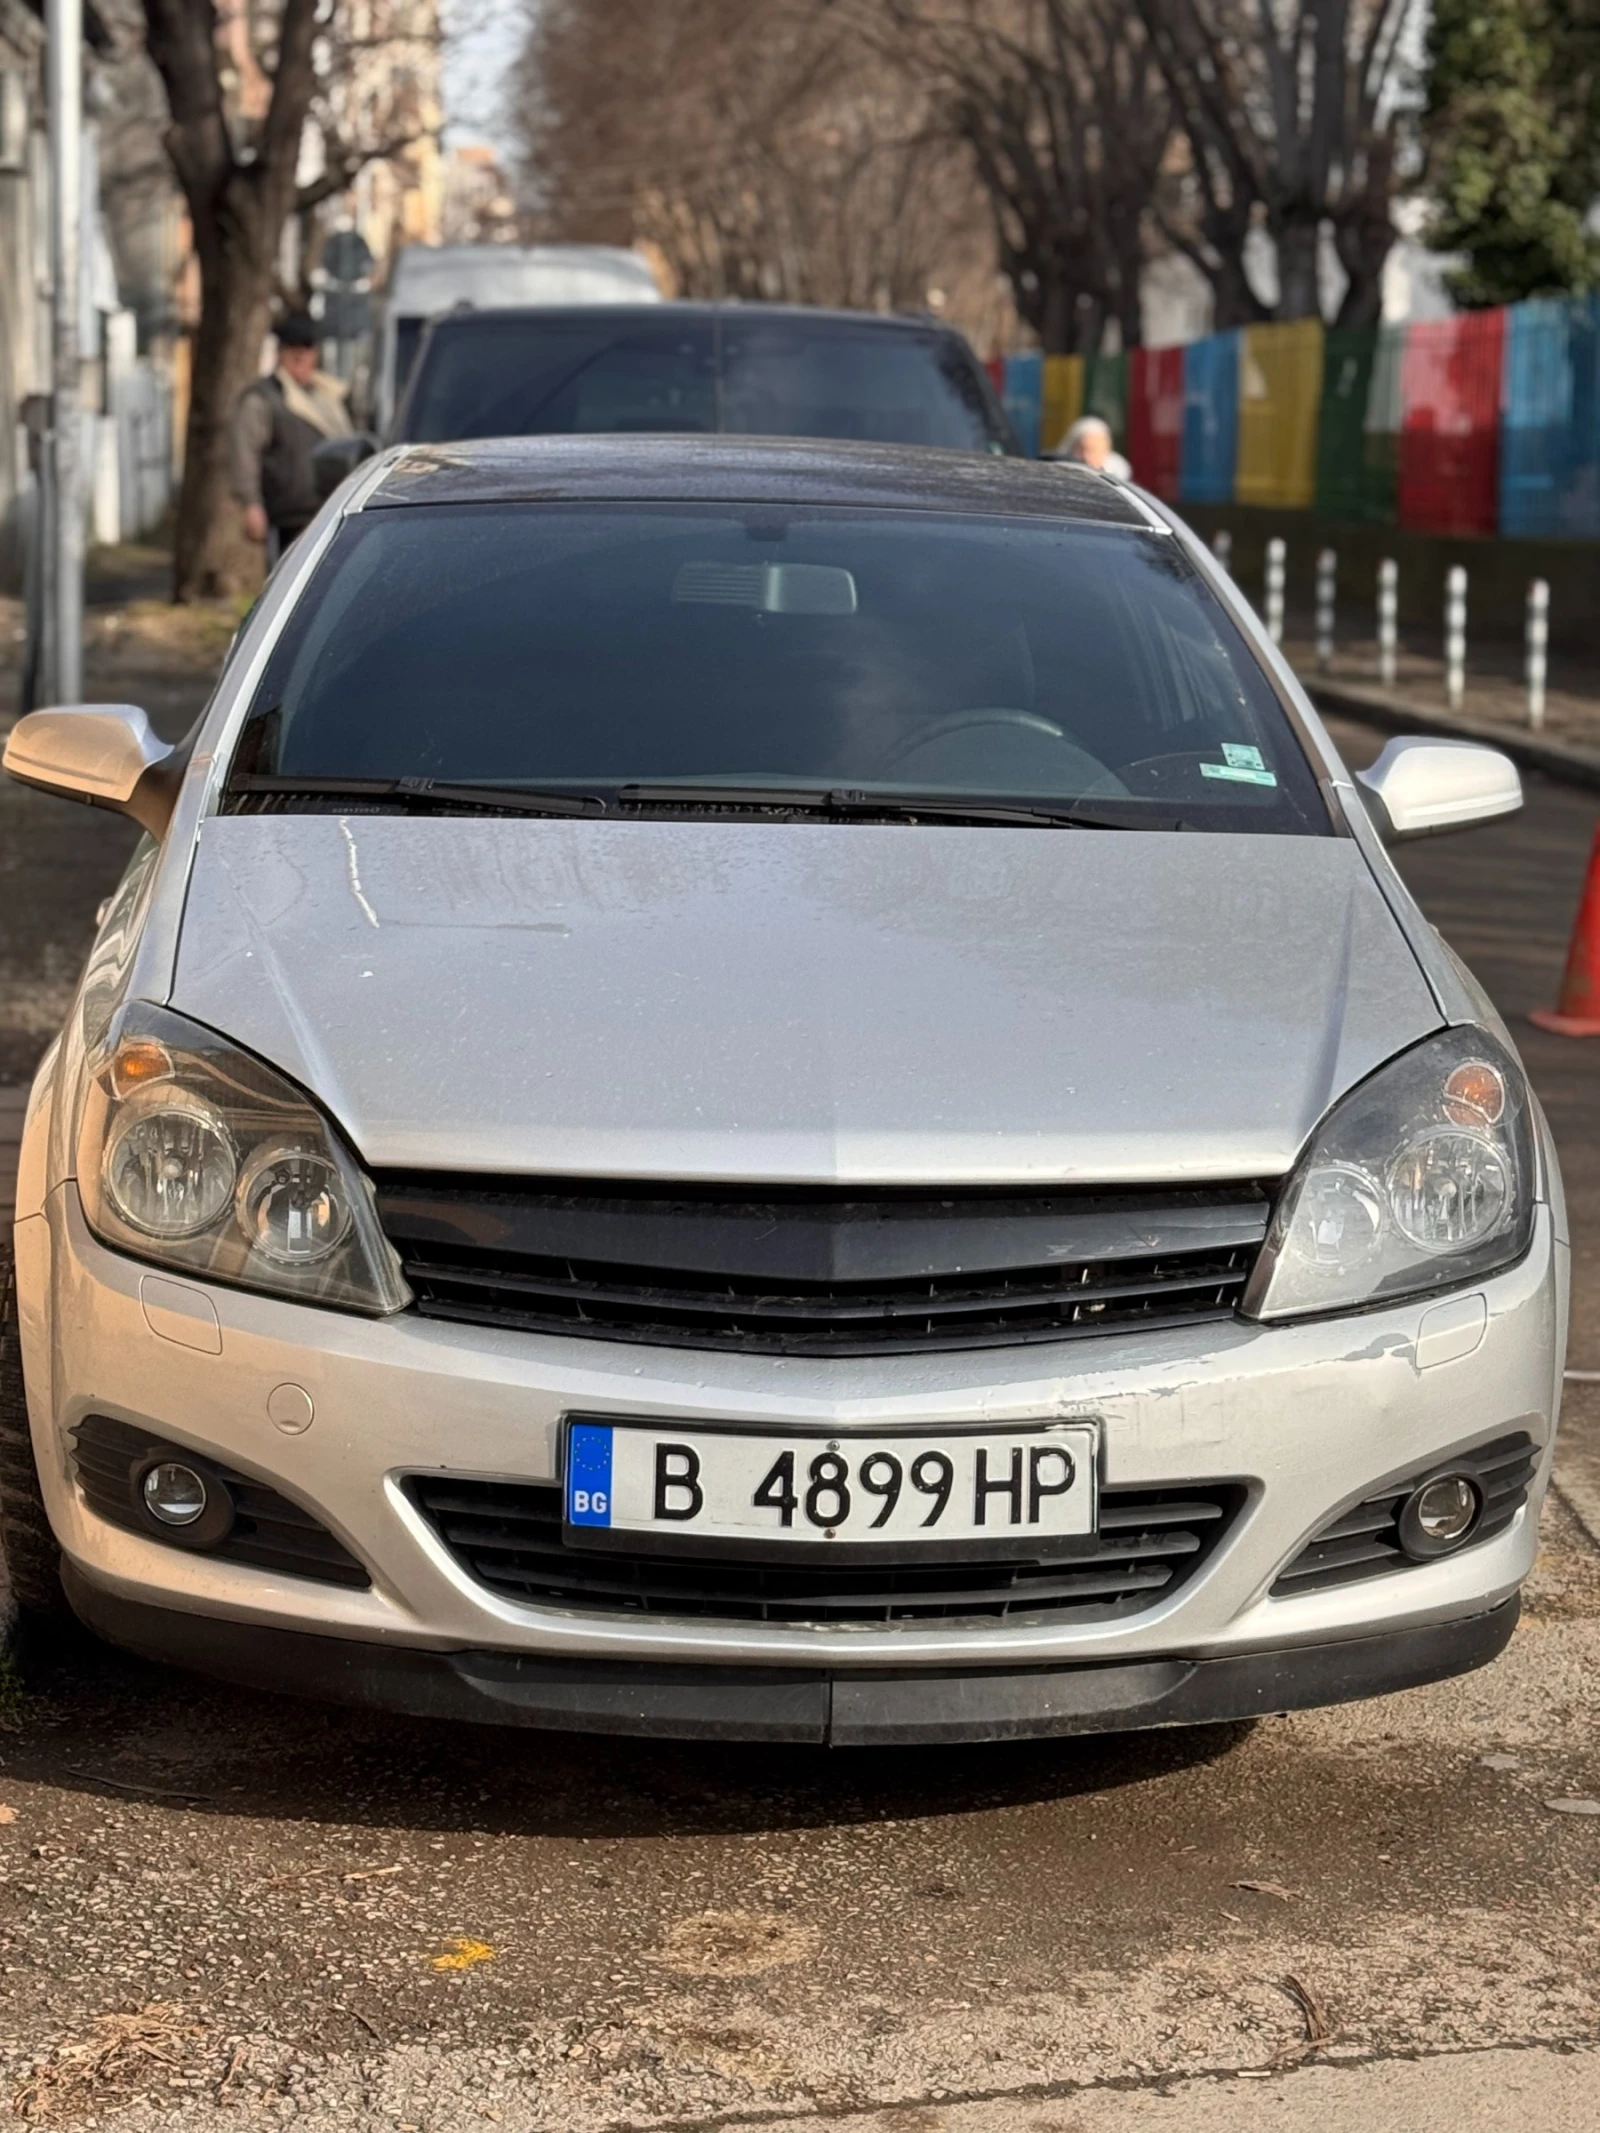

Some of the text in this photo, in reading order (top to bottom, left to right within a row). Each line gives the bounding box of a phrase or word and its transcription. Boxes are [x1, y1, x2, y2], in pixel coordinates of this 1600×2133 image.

[574, 1490, 607, 1514] BG
[653, 1442, 1077, 1528] B 4899 HP
